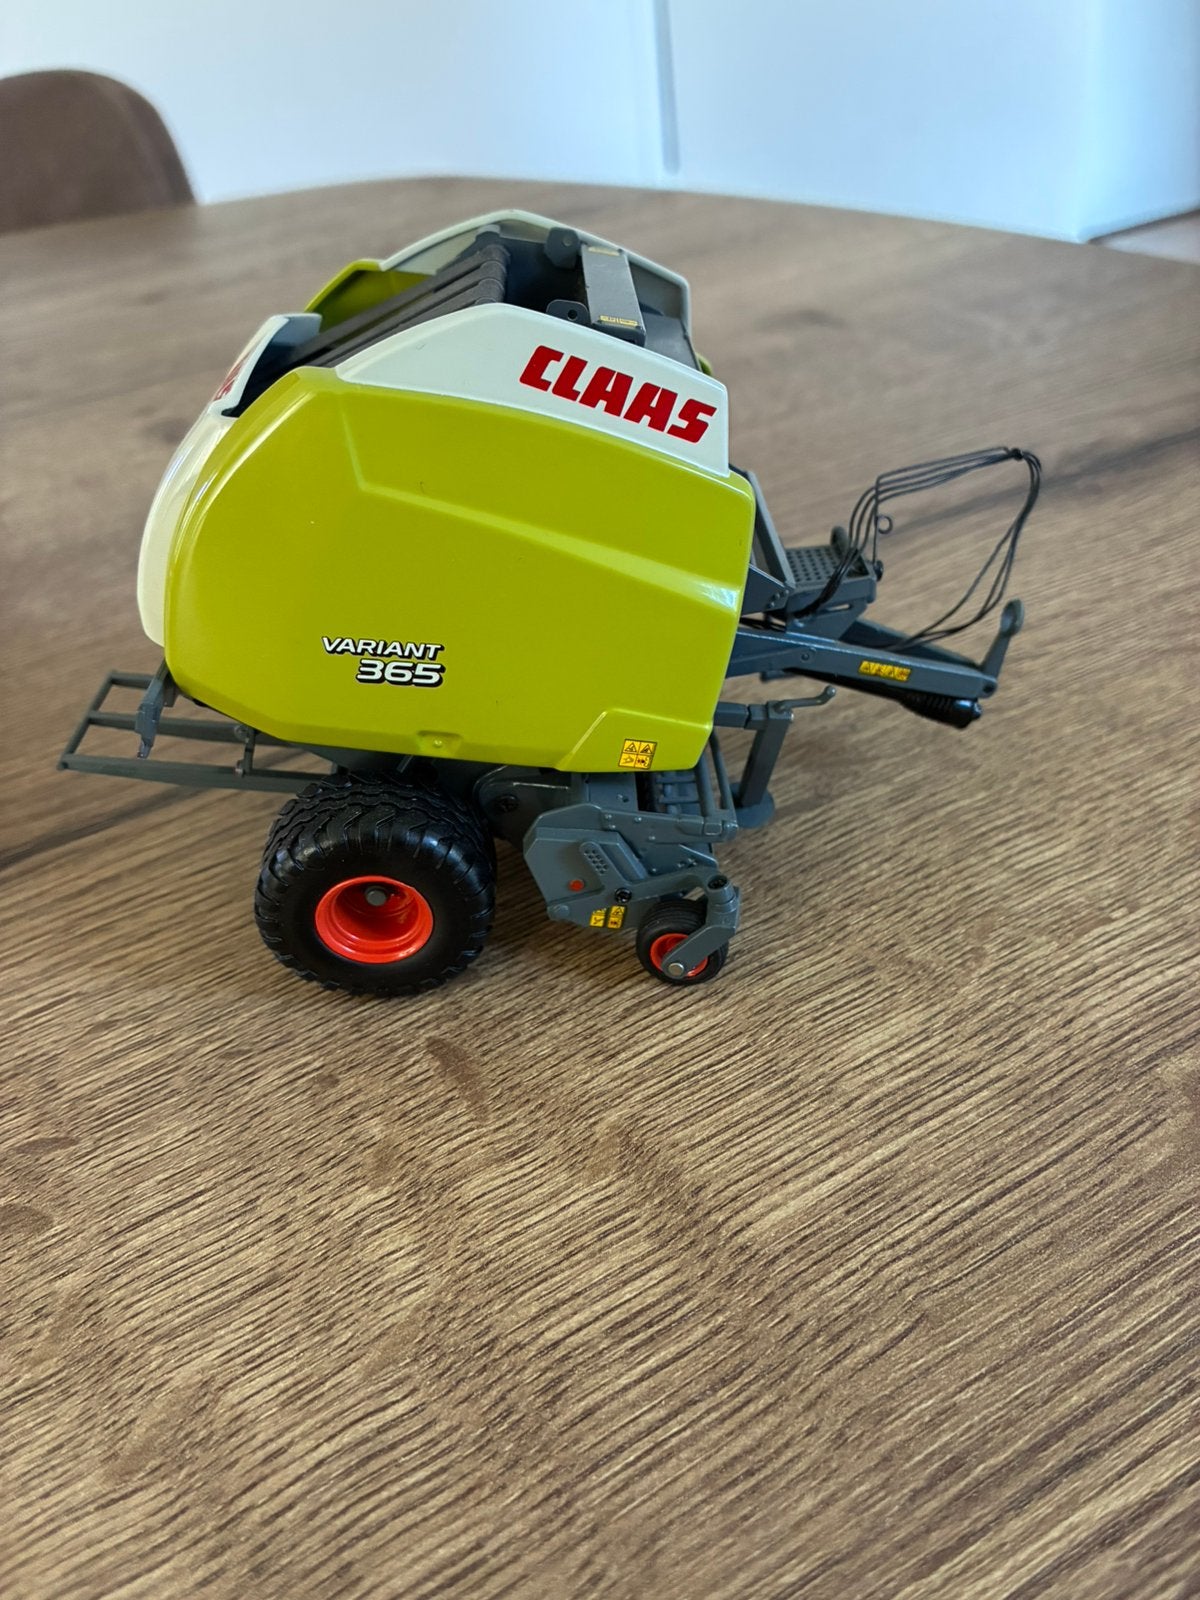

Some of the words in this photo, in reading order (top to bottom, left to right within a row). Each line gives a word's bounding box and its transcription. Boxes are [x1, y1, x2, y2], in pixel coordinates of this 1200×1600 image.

[519, 345, 718, 443] CLAAS
[322, 636, 444, 660] VARIANT
[356, 658, 446, 688] 365
